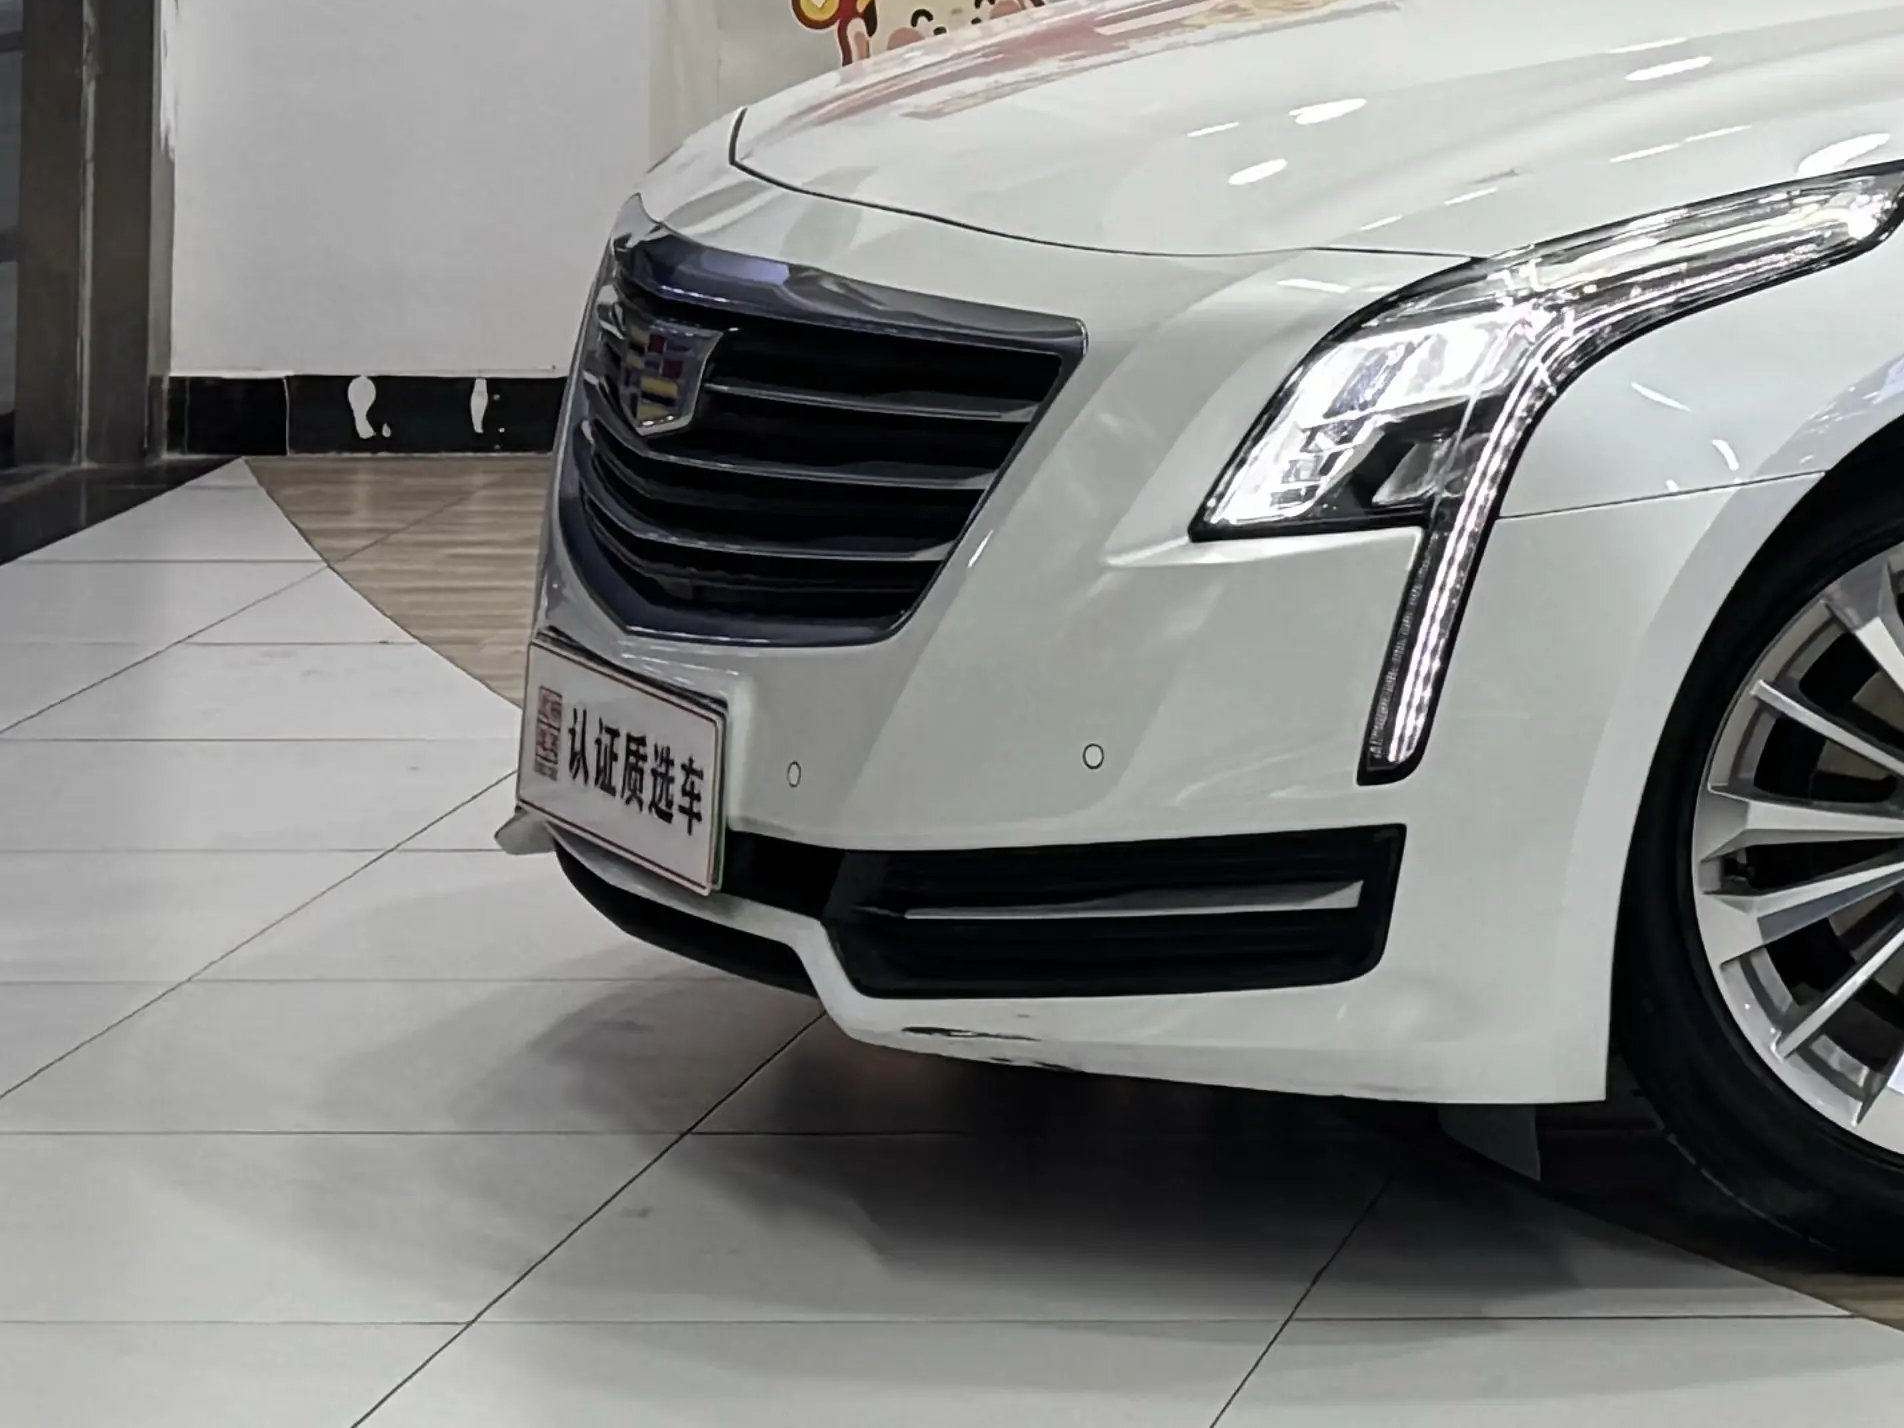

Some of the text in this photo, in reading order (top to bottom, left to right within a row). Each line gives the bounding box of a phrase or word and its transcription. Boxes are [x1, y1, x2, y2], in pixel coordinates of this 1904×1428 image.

[568, 706, 705, 837] 认证质选车
